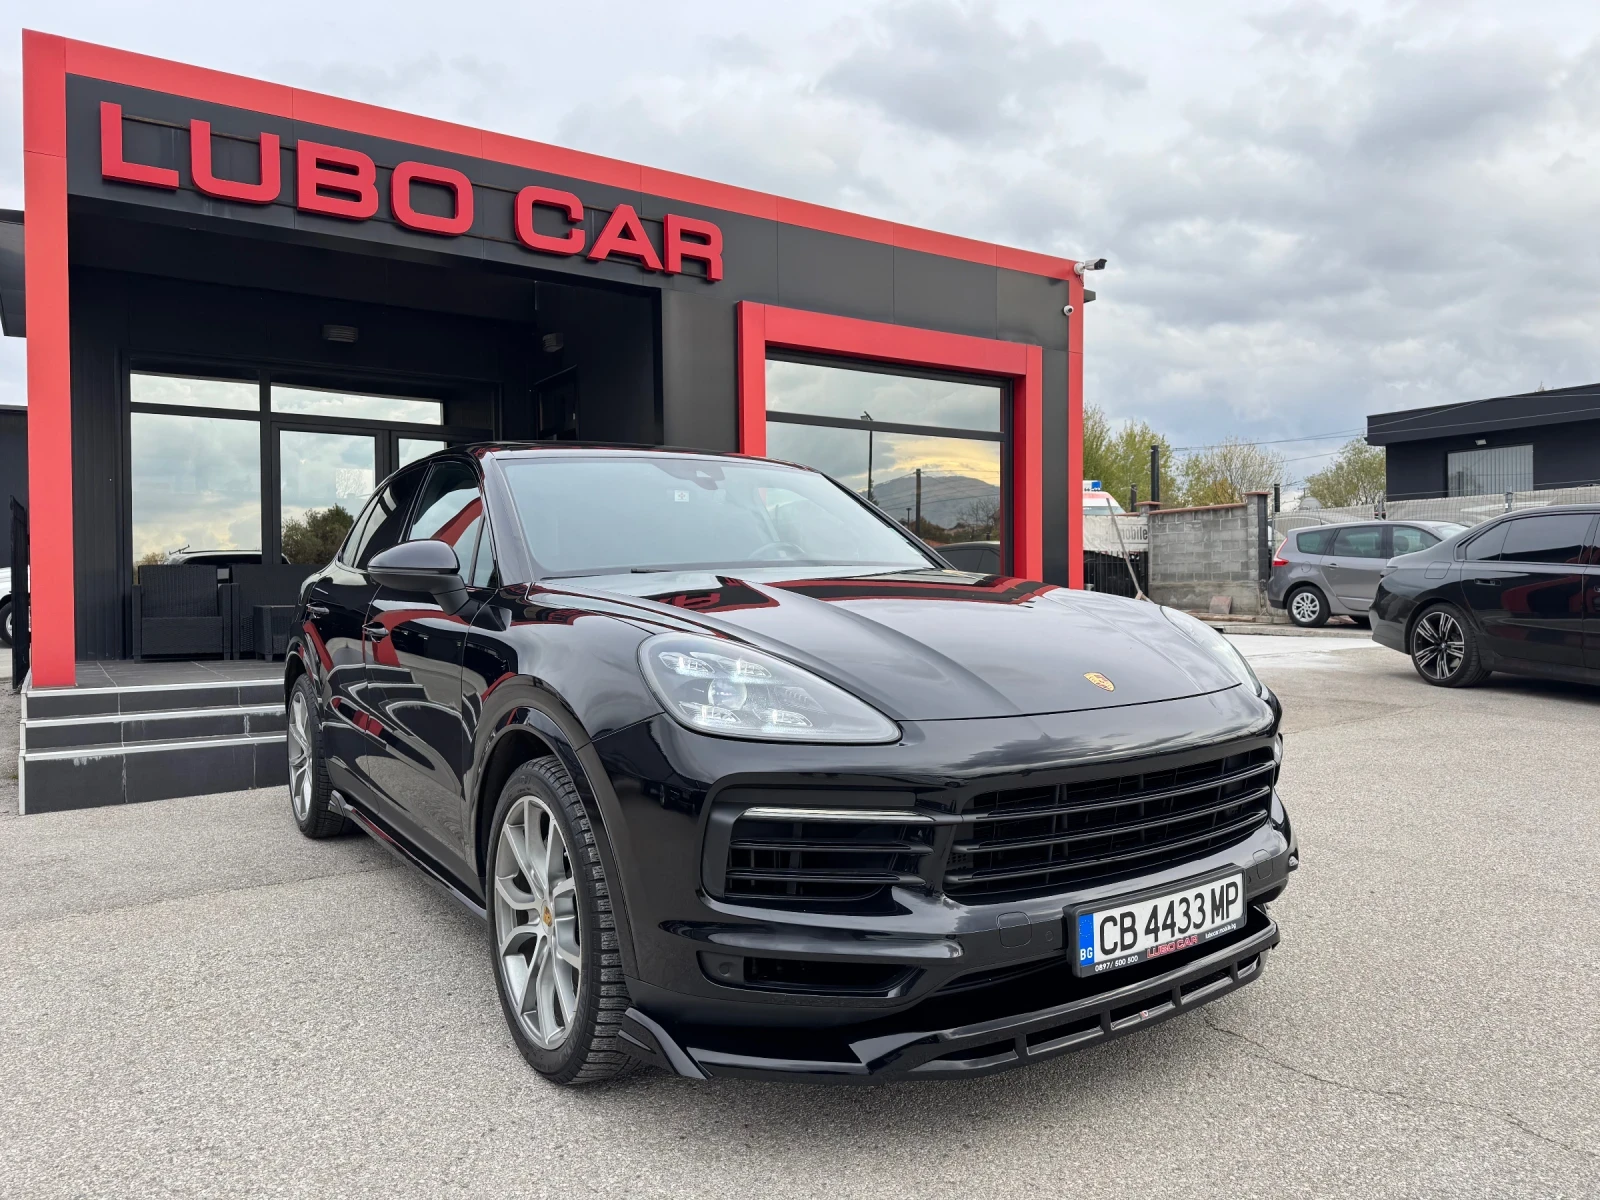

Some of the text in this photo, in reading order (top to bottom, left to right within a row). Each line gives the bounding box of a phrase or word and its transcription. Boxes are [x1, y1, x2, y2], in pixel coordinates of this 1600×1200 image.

[100, 101, 724, 282] LUBO CAR
[1099, 881, 1239, 956] CB 4433 MP
[1080, 947, 1094, 961] BG
[1146, 934, 1199, 959] LUBO CAR
[1127, 955, 1139, 964] 500
